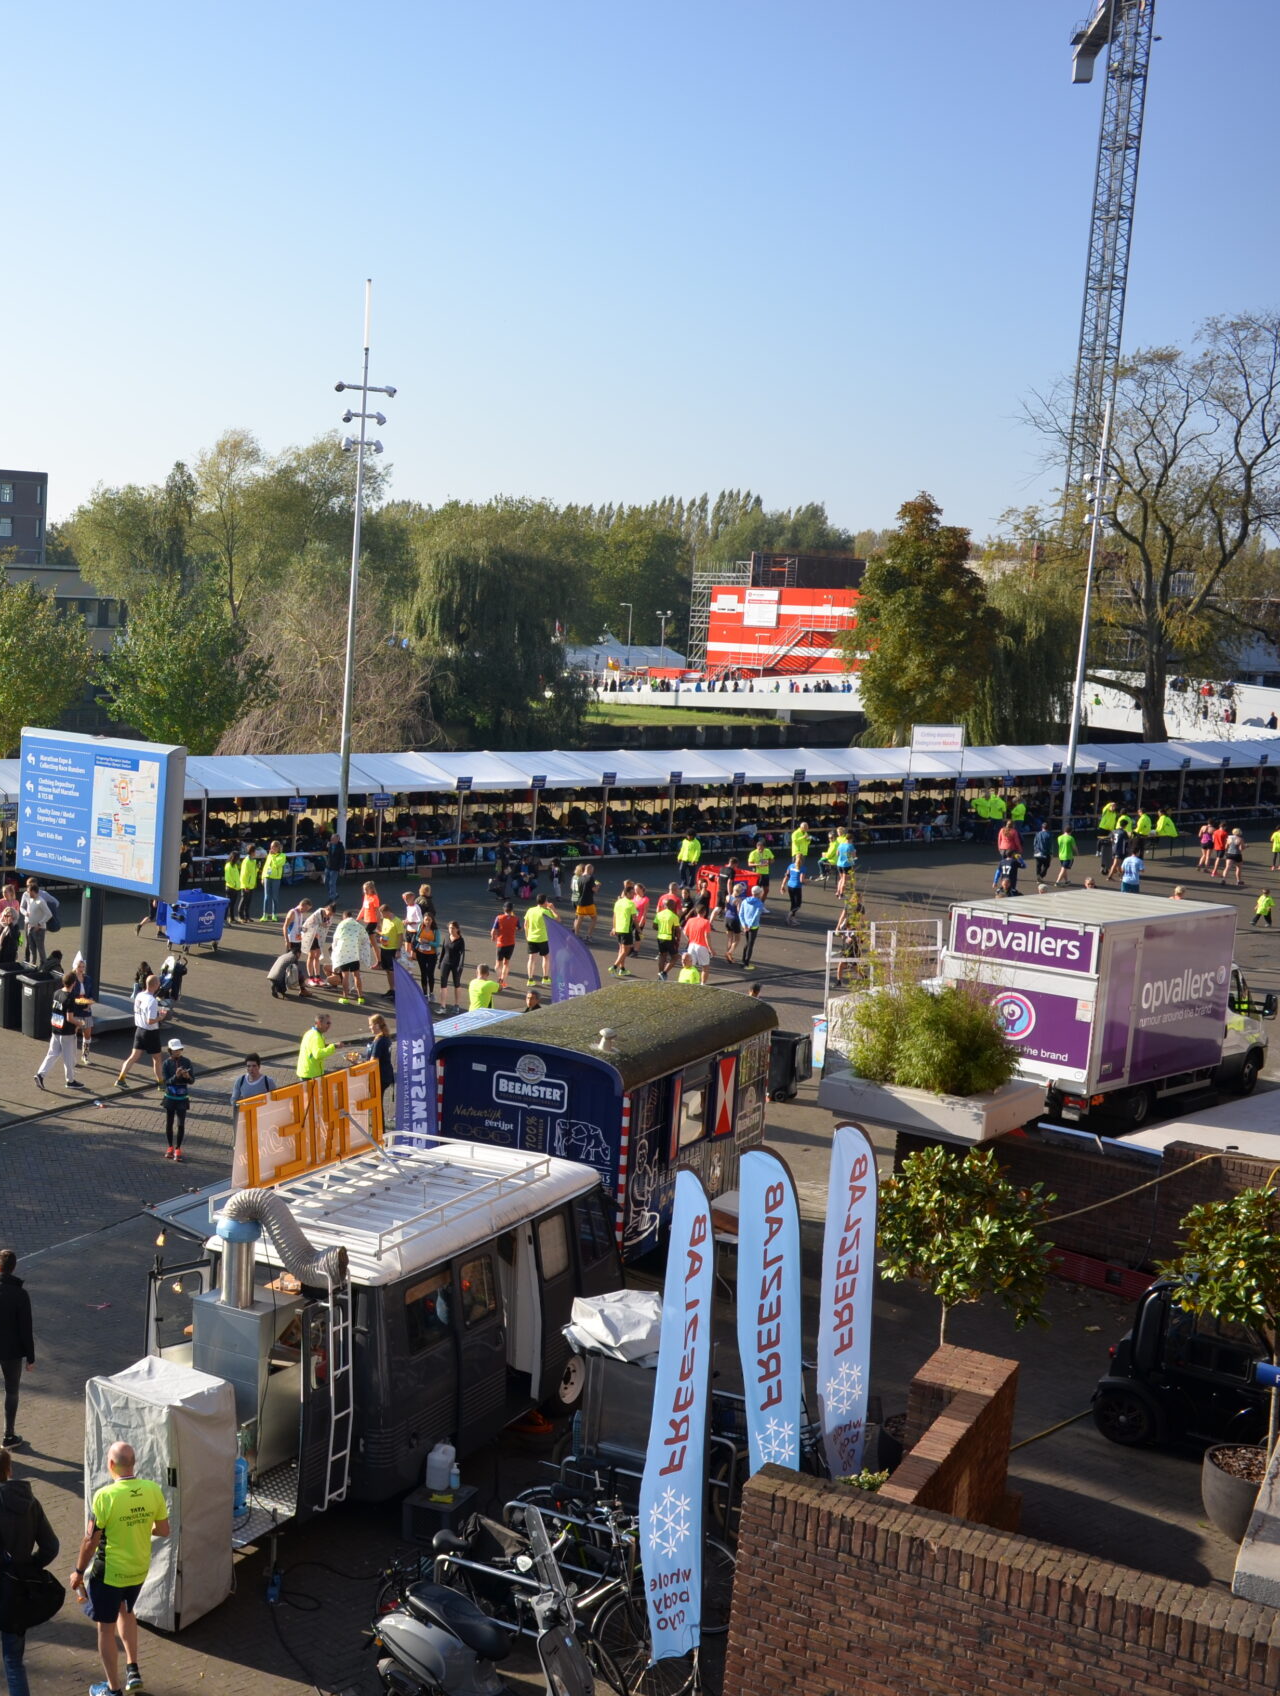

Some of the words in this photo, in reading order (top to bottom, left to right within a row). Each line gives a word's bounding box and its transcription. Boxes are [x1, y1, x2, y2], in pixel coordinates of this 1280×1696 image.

[39, 755, 59, 763] Marathon
[39, 762, 59, 771] Collecting
[38, 778, 54, 787] Clothing
[55, 780, 75, 789] Depository
[61, 788, 79, 797] Marathon
[37, 807, 50, 816] Charity
[50, 809, 60, 817] Zone
[36, 830, 46, 838] Start
[55, 833, 63, 841] Run
[1002, 865, 1012, 876] 17
[966, 925, 1081, 960] opvallers
[1141, 968, 1216, 1013] opvallers
[1040, 1048, 1069, 1062] brand
[499, 1078, 561, 1101] BEEMSTER
[484, 1119, 514, 1131] gerijpt
[525, 1115, 538, 1149] 100%
